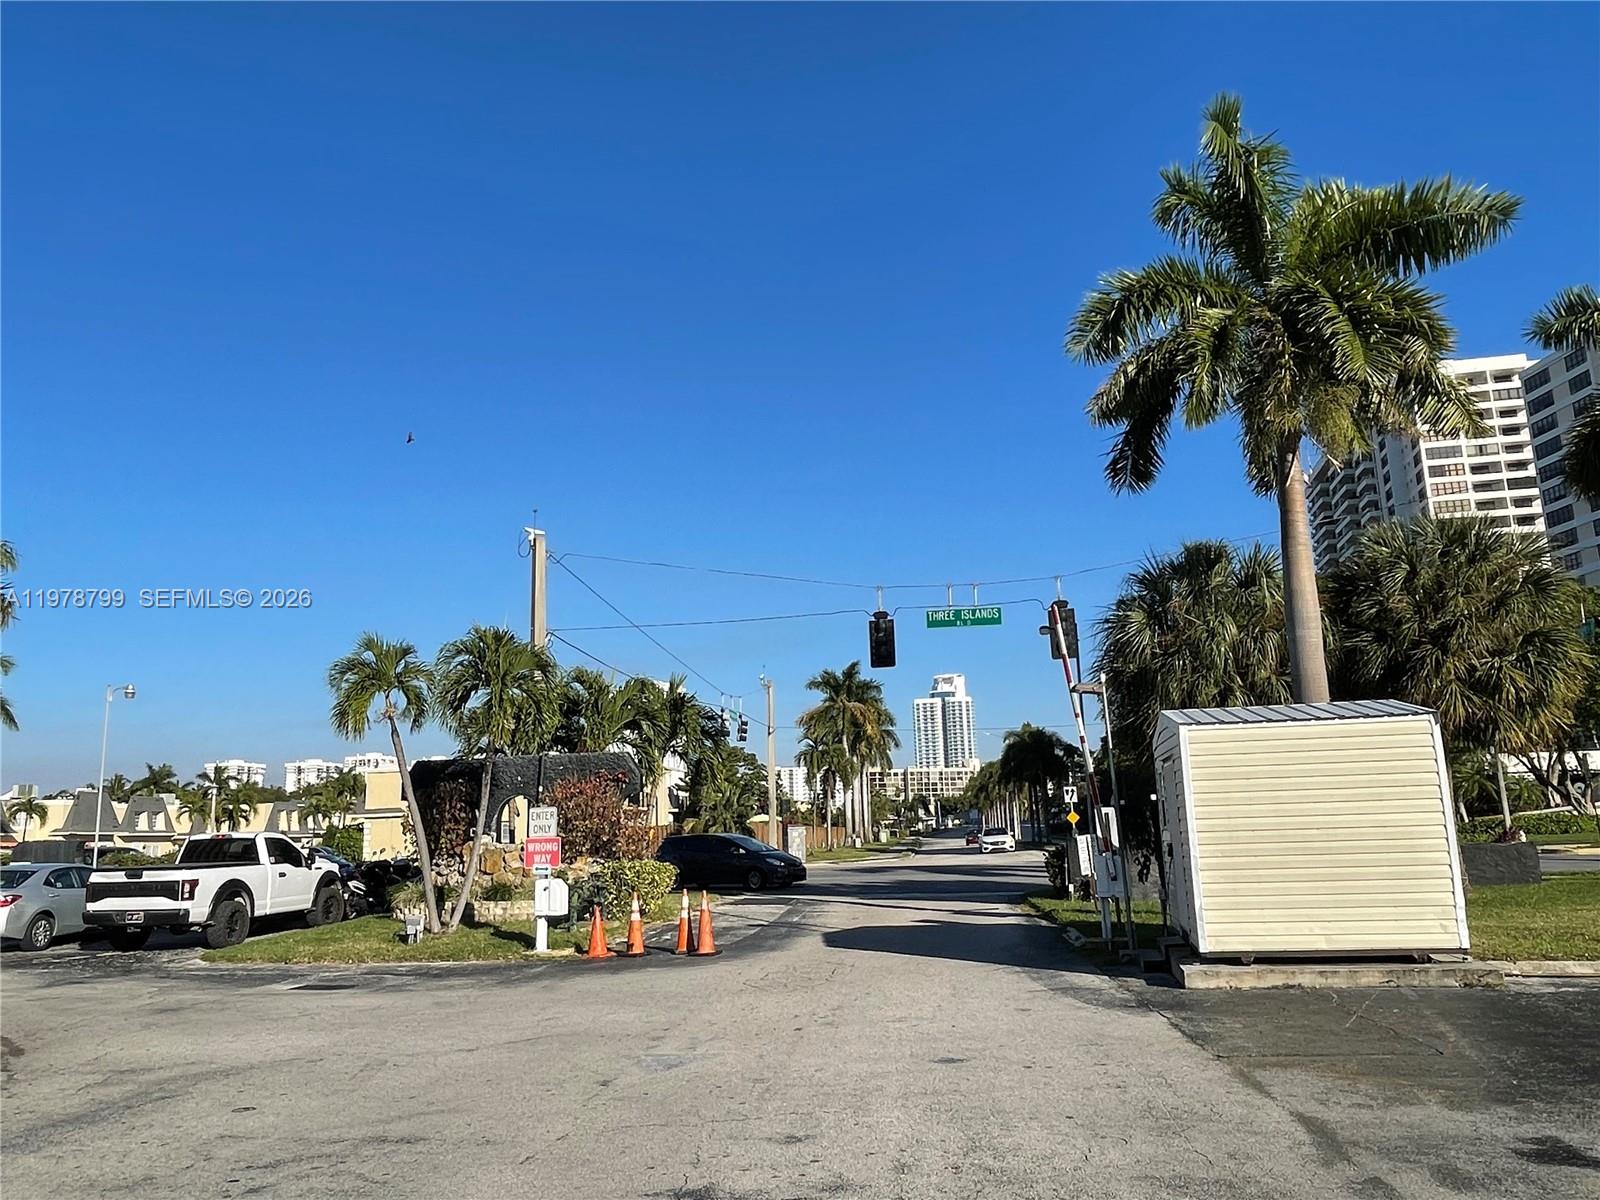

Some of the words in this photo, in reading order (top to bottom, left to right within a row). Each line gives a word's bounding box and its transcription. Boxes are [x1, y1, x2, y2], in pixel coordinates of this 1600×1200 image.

[928, 610, 956, 621] THREE
[961, 608, 999, 620] ISLANDS
[531, 811, 555, 821] ENTER
[533, 824, 552, 834] ONLY
[527, 842, 559, 852] WRONG
[533, 854, 552, 864] WAY
